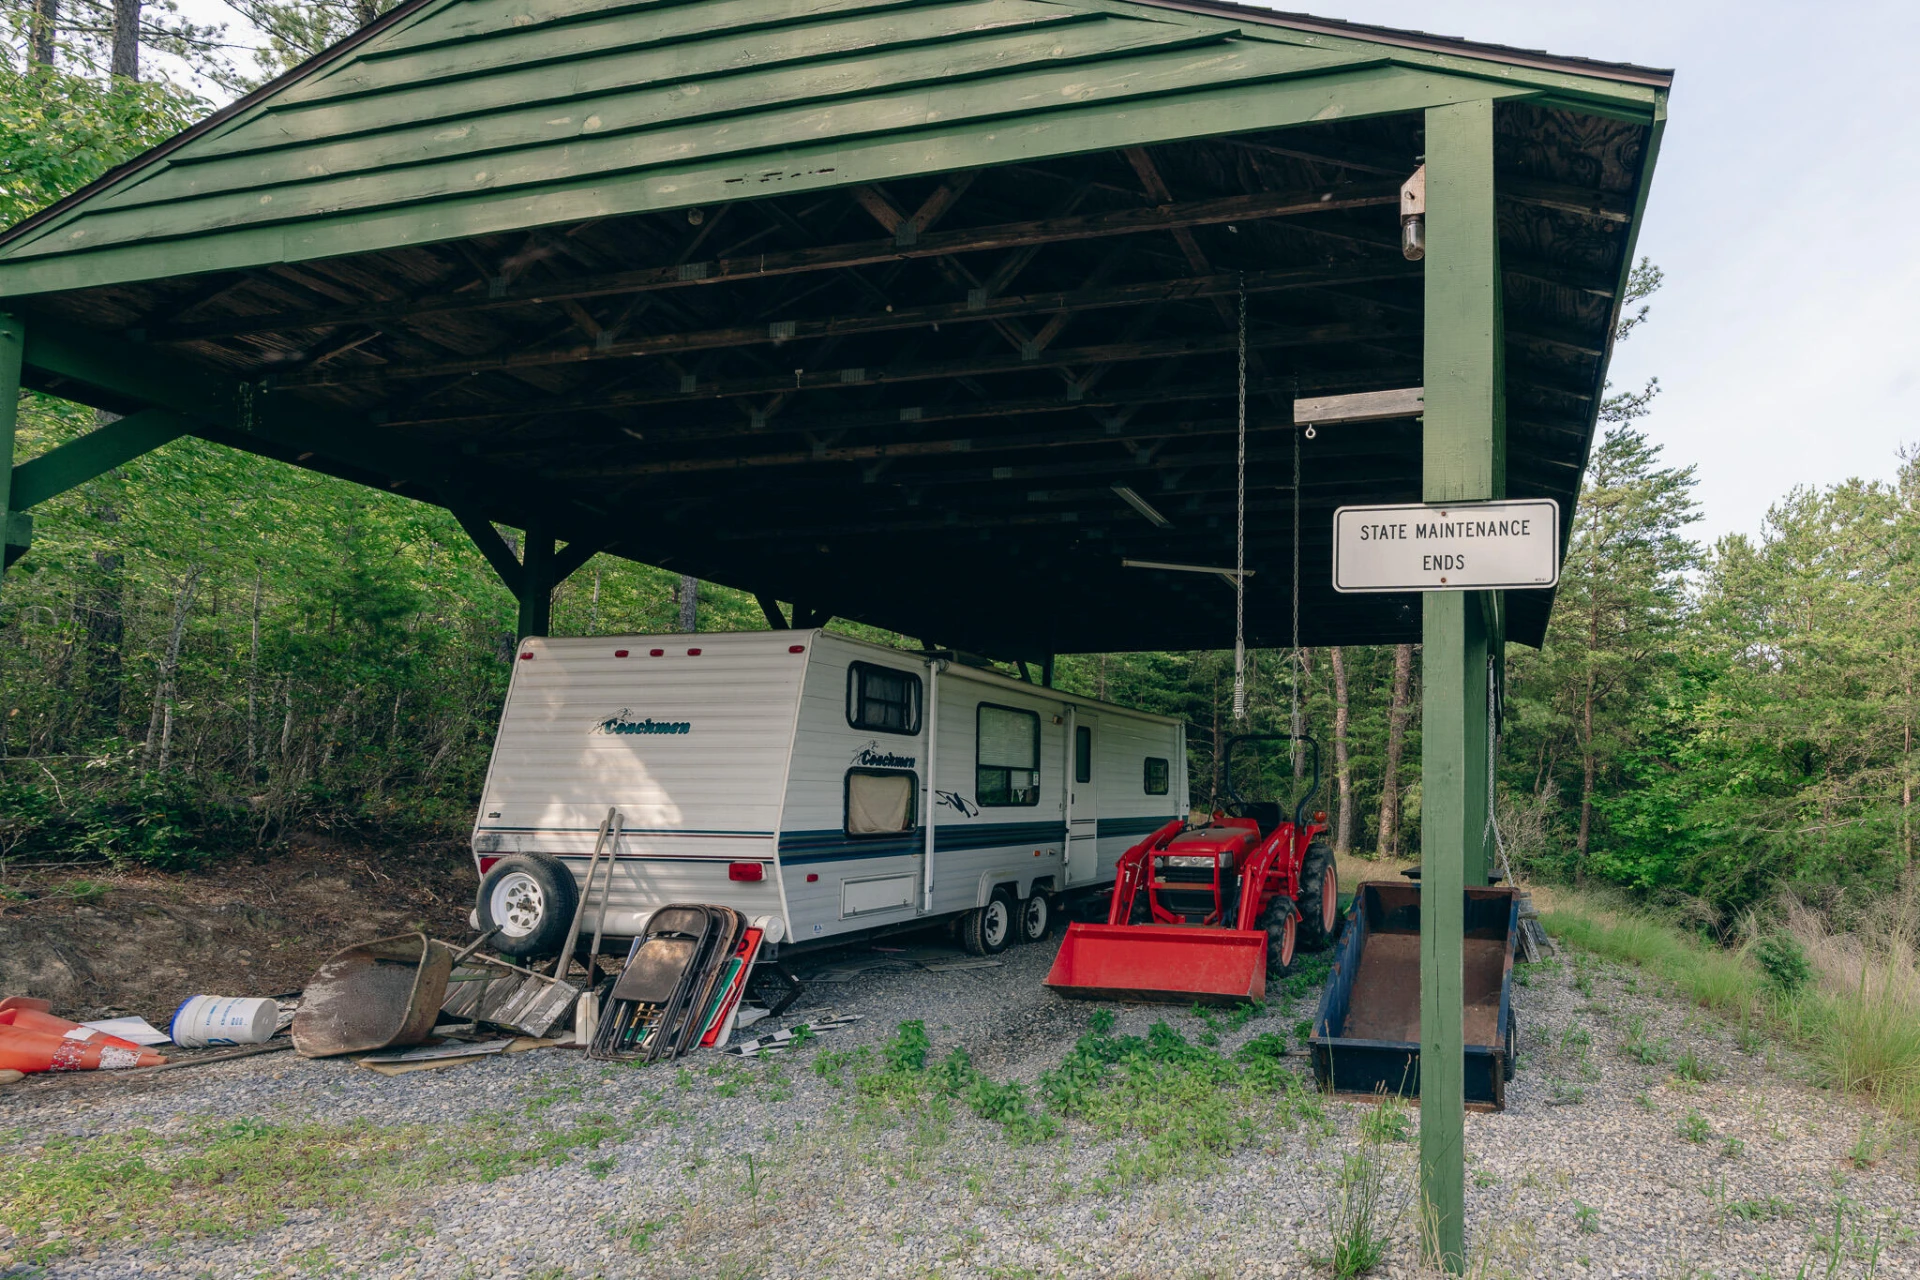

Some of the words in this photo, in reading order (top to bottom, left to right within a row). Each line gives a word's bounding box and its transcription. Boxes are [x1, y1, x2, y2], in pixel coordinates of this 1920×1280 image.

[1360, 524, 1407, 541] STATE
[1415, 519, 1531, 539] MAINTENANCE
[1423, 554, 1465, 571] ENDS
[604, 717, 691, 735] Coachmen
[860, 748, 916, 768] Coachmen
